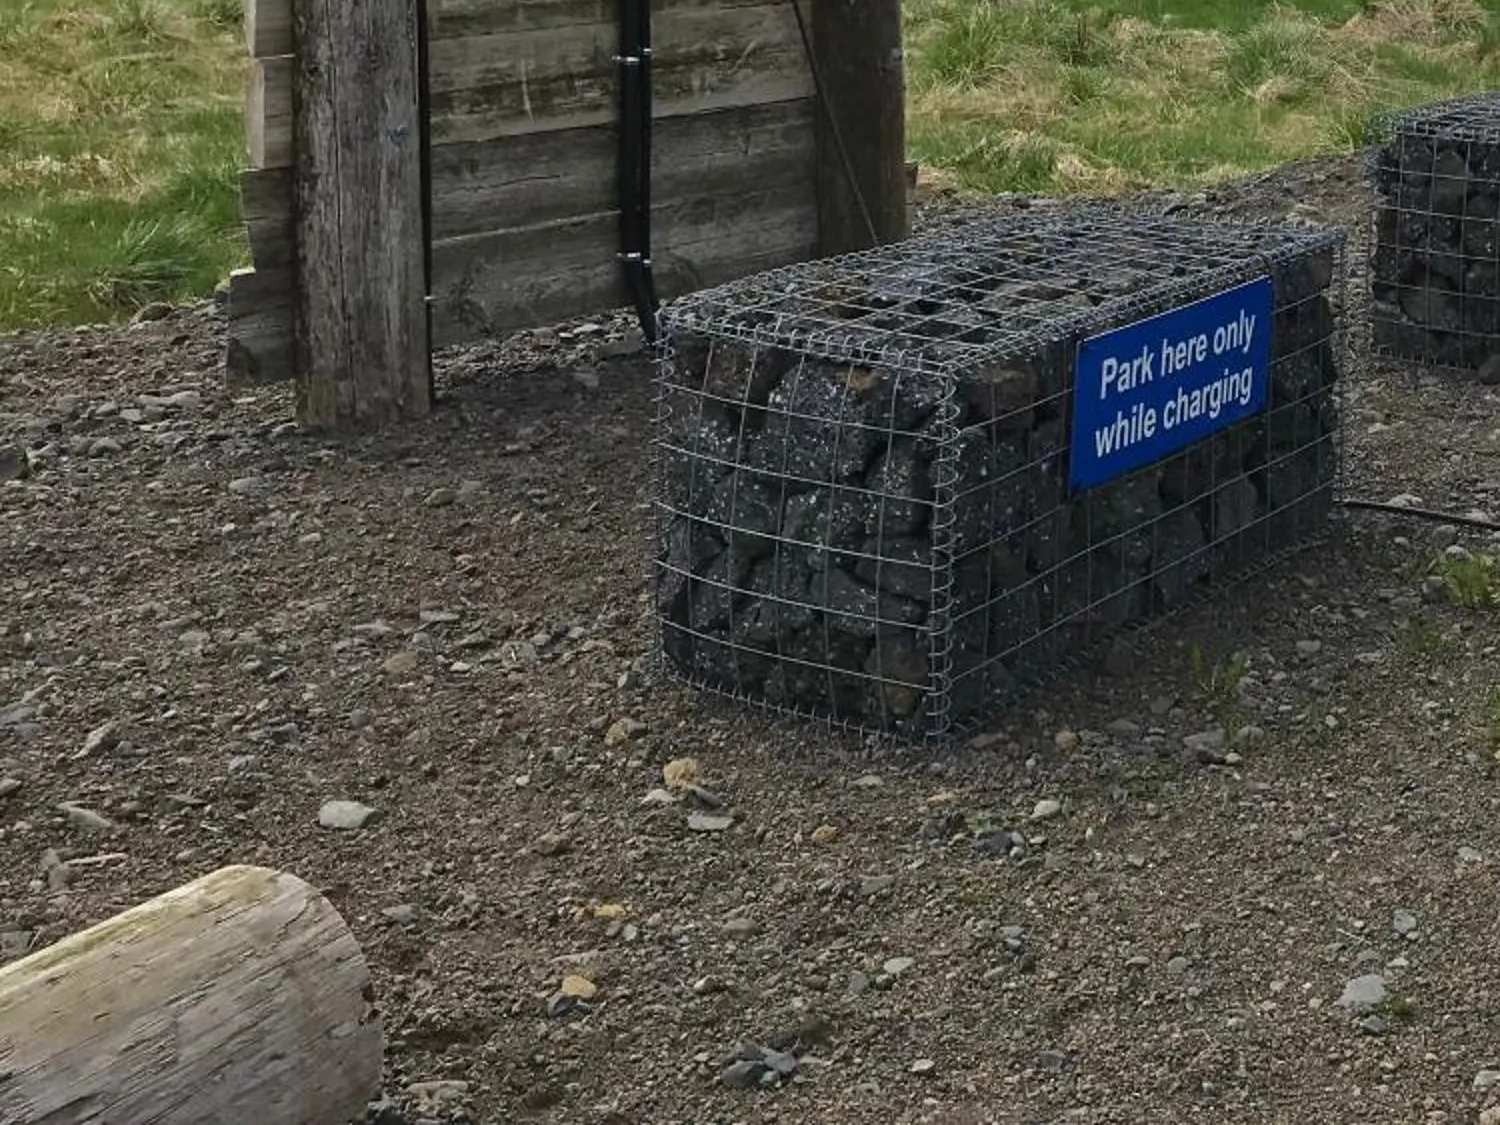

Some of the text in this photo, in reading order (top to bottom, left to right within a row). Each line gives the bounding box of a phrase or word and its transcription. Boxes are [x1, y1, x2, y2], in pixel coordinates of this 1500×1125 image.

[1100, 308, 1256, 400] Park here only
[1095, 366, 1253, 458] while charging
